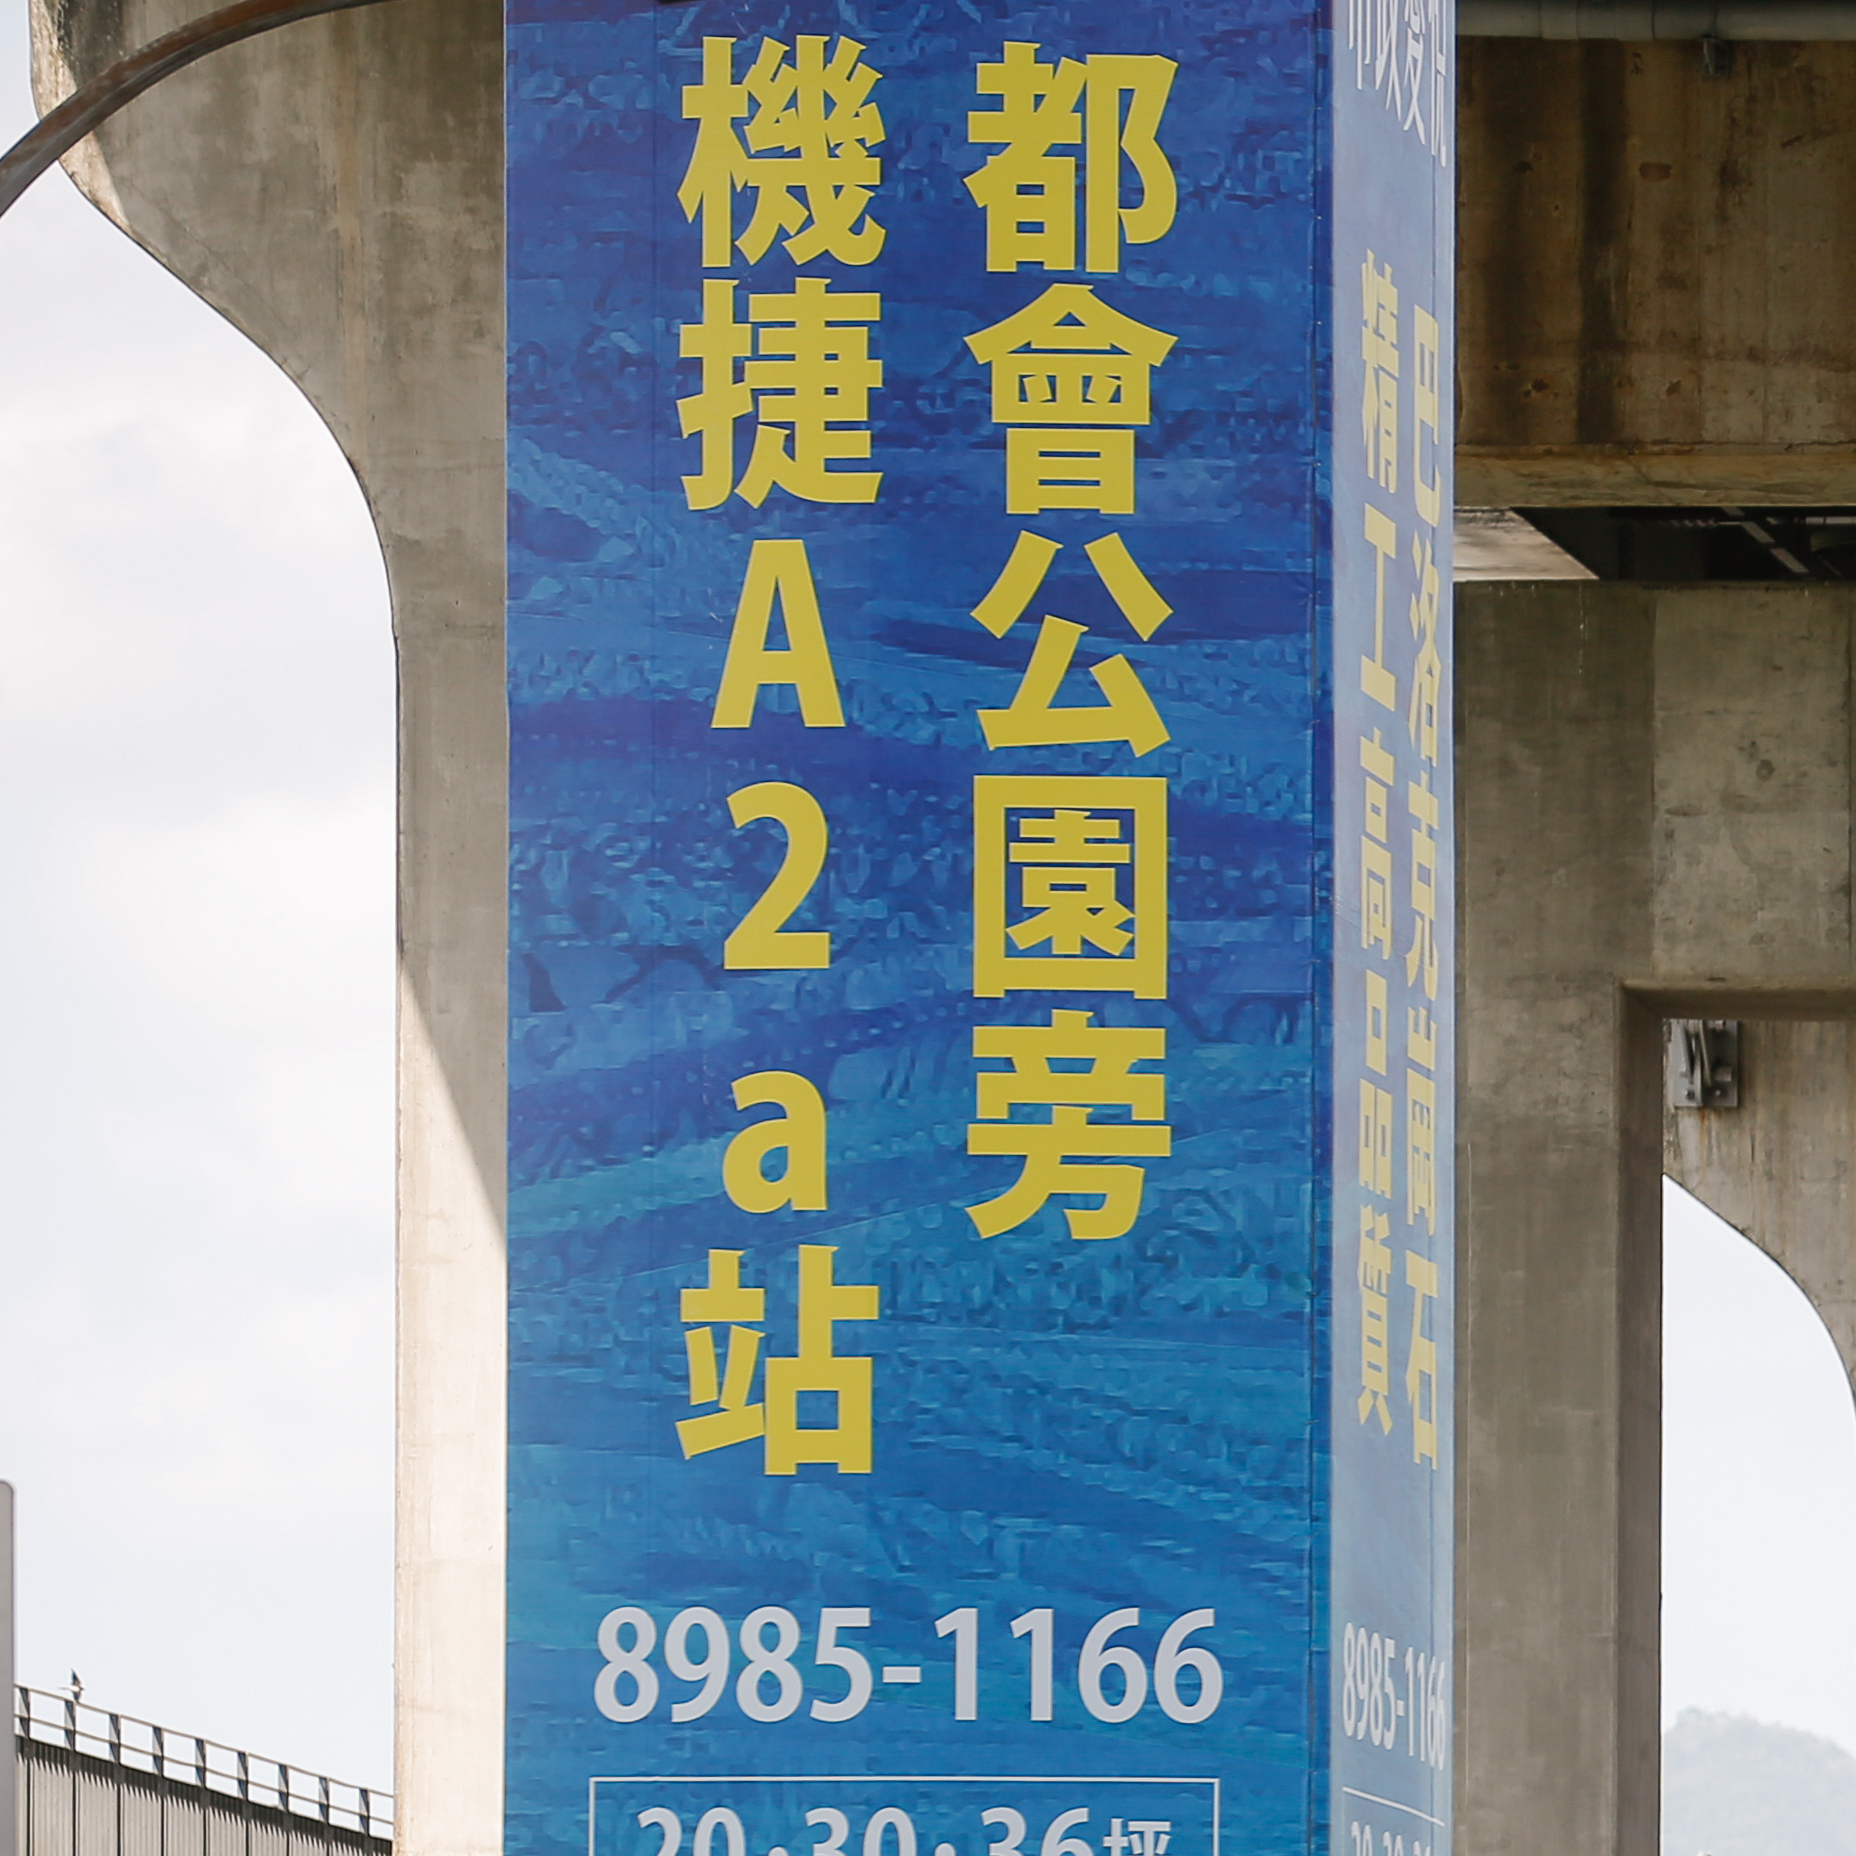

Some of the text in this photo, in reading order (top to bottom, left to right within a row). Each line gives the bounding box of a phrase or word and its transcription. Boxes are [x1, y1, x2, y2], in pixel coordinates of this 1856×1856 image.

[676, 36, 884, 1475] 機捷A2a站
[965, 42, 1177, 1240] 都會公園旁
[1357, 249, 1398, 1436] 精工高品質
[594, 1606, 1223, 1723] 8985-1166
[1342, 1622, 1446, 1770] 8985-1166
